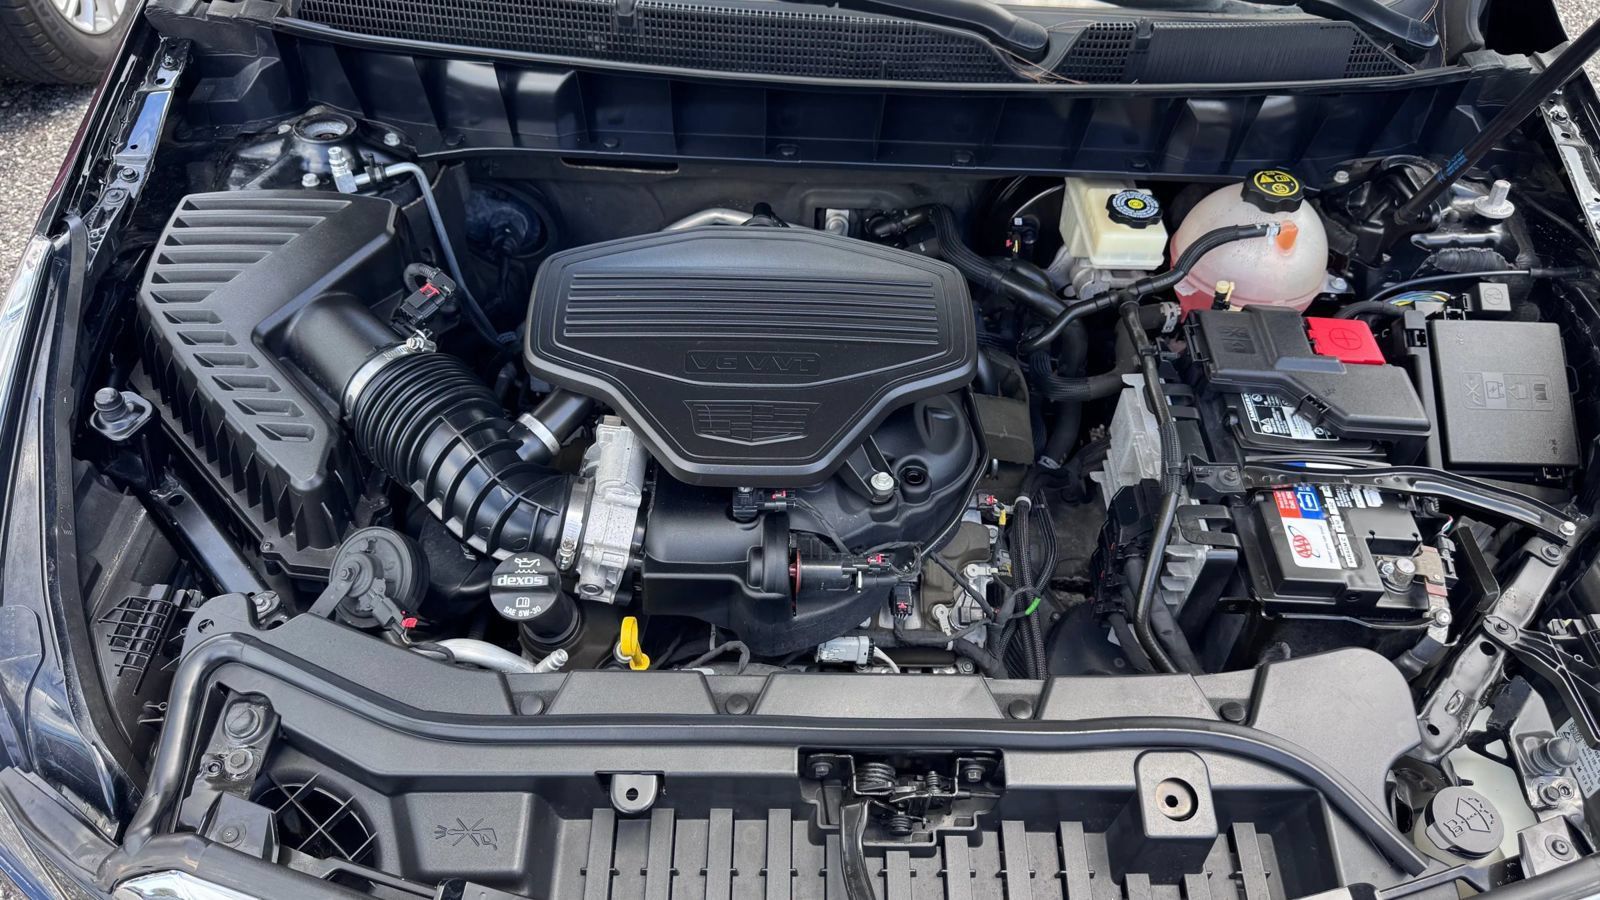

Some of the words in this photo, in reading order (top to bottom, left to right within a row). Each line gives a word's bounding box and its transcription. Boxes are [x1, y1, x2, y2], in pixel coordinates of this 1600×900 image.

[691, 354, 737, 369] V6
[746, 355, 815, 371] VVT
[1293, 535, 1312, 558] AAA
[497, 575, 545, 585] dexos
[503, 605, 517, 616] SAE
[518, 605, 541, 617] 5W-30
